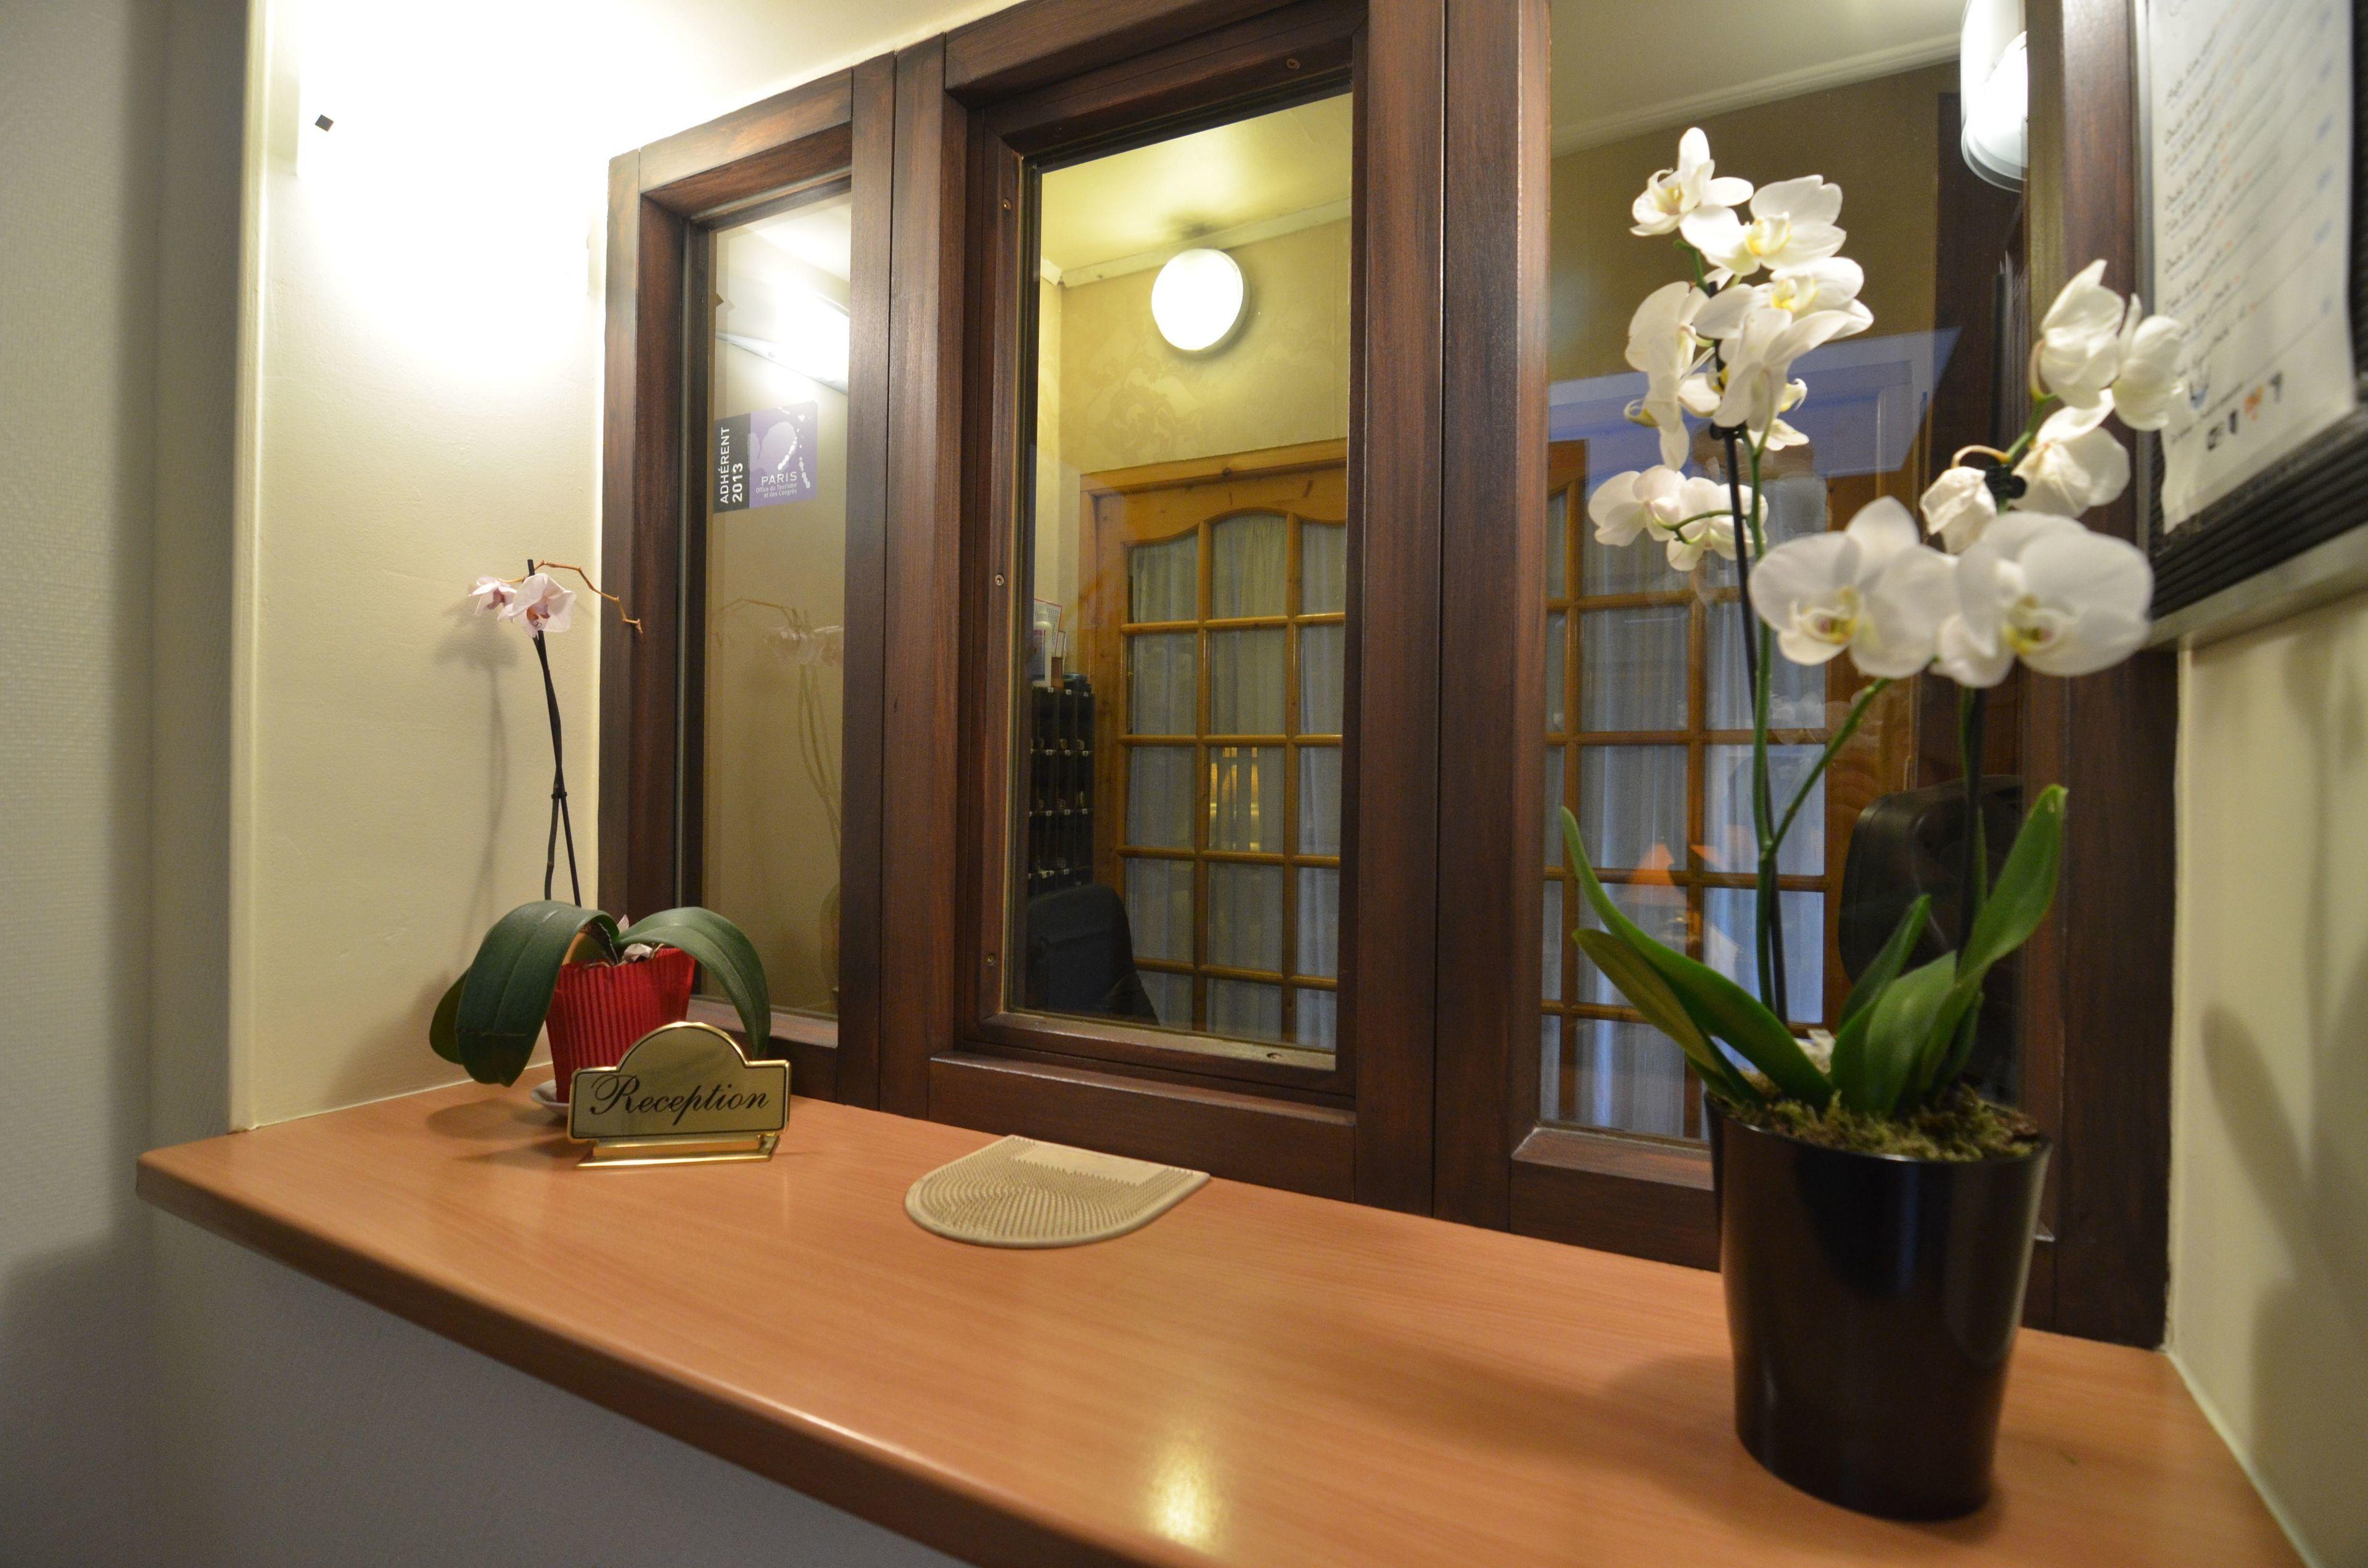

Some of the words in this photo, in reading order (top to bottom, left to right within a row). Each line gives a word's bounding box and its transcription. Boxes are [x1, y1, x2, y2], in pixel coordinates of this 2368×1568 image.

[718, 427, 730, 504] ADHÉRENT
[732, 462, 743, 503] 2013
[761, 471, 797, 486] PARIS
[590, 1074, 770, 1126] Reception
